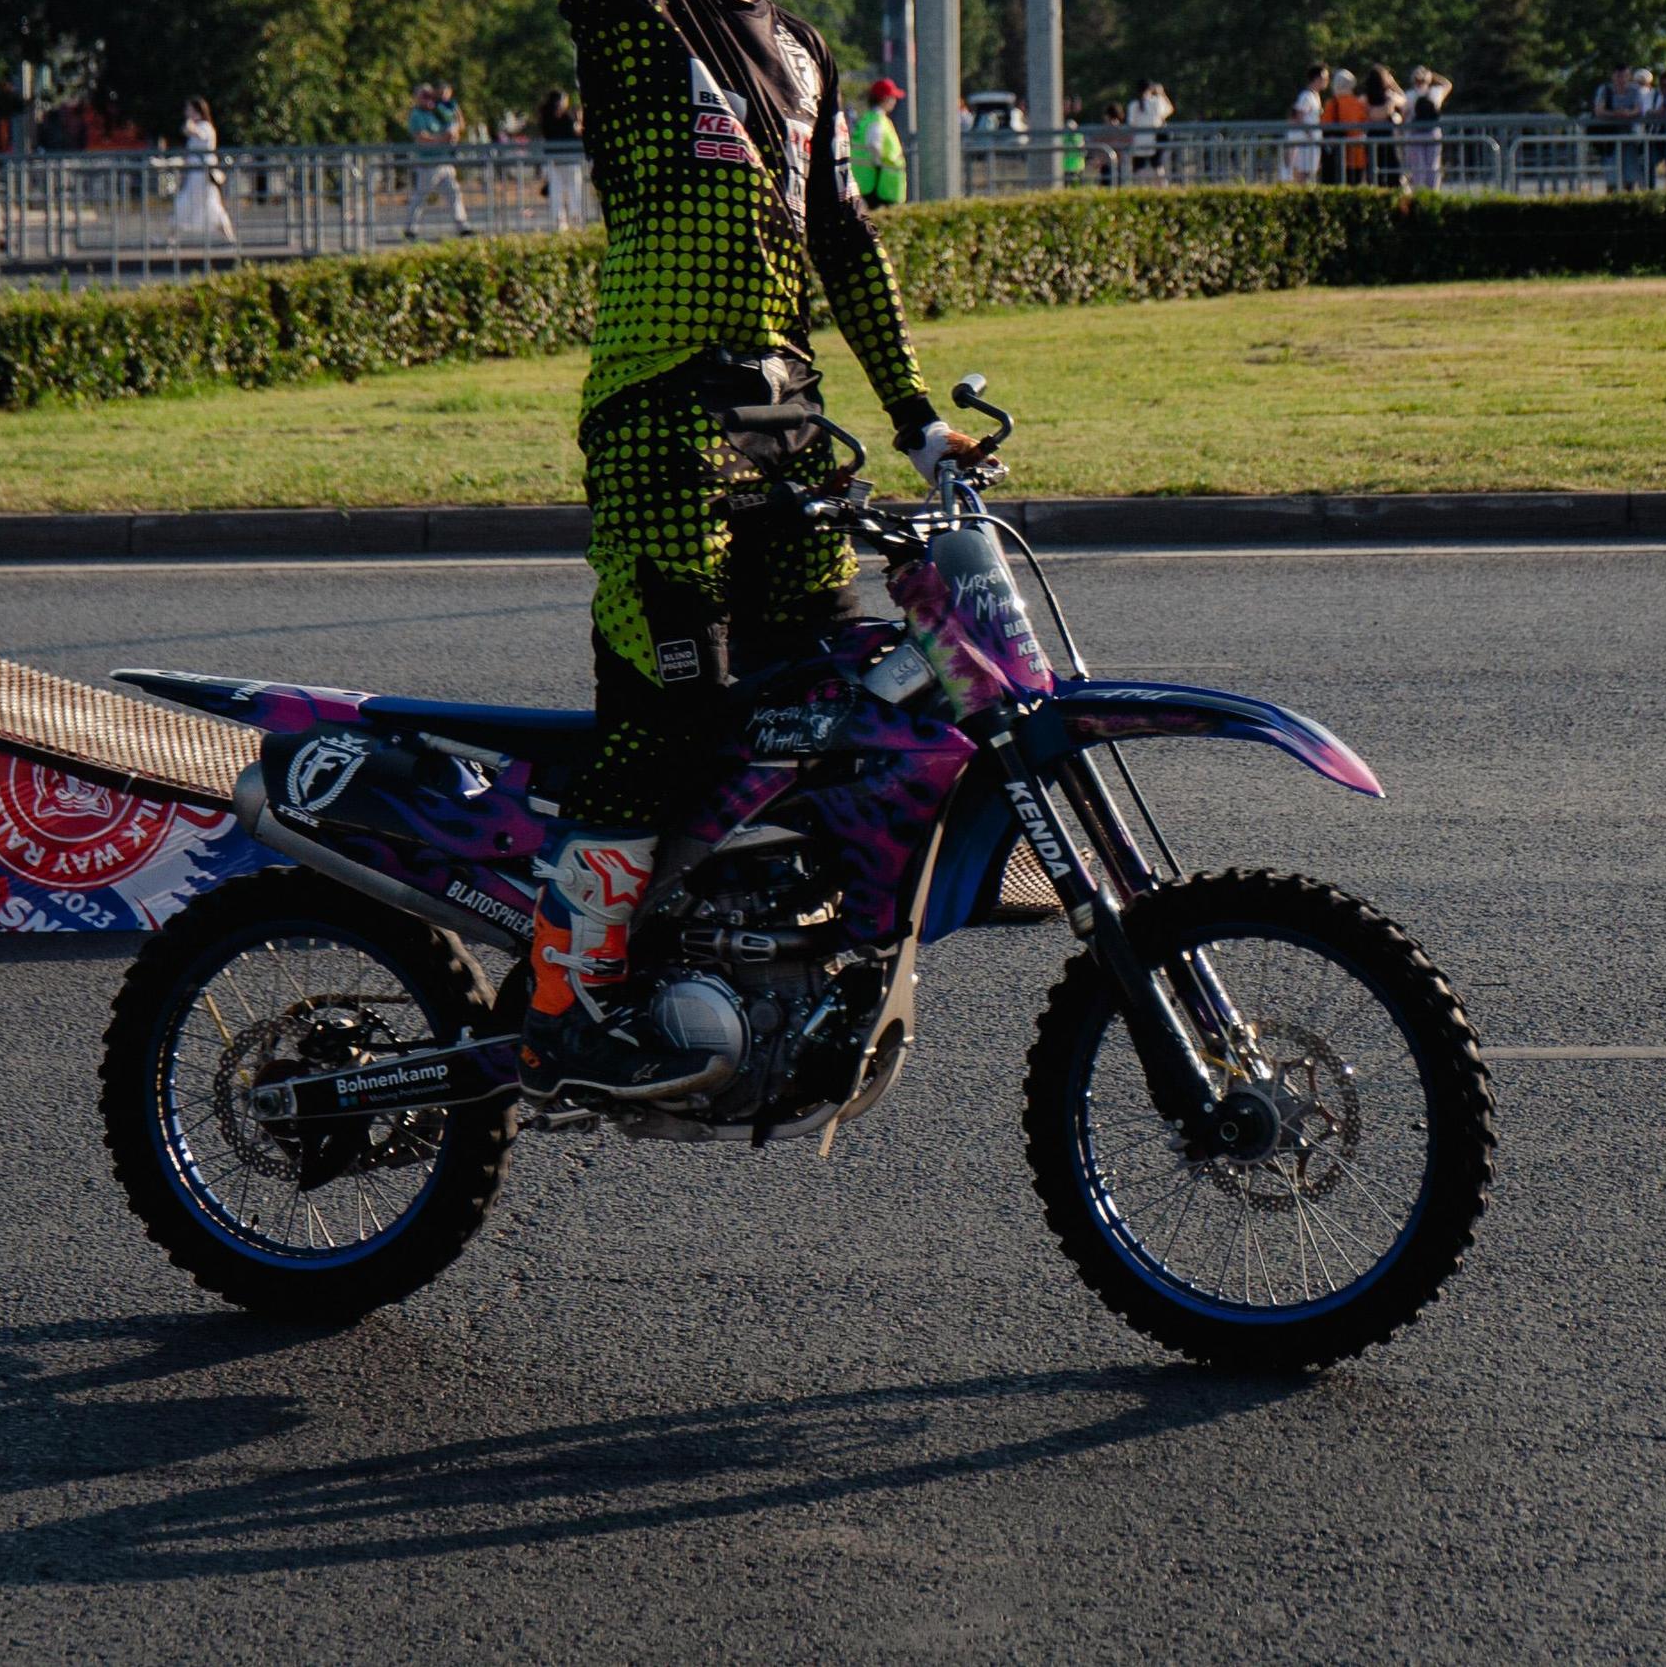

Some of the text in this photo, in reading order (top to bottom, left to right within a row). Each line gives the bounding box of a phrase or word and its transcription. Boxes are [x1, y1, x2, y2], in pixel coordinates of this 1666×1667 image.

[119, 797, 164, 847] ILK
[1004, 781, 1072, 881] KENDA
[51, 840, 126, 875] WAY
[47, 890, 118, 930] 2023
[336, 1063, 449, 1095] Bohnenkamp
